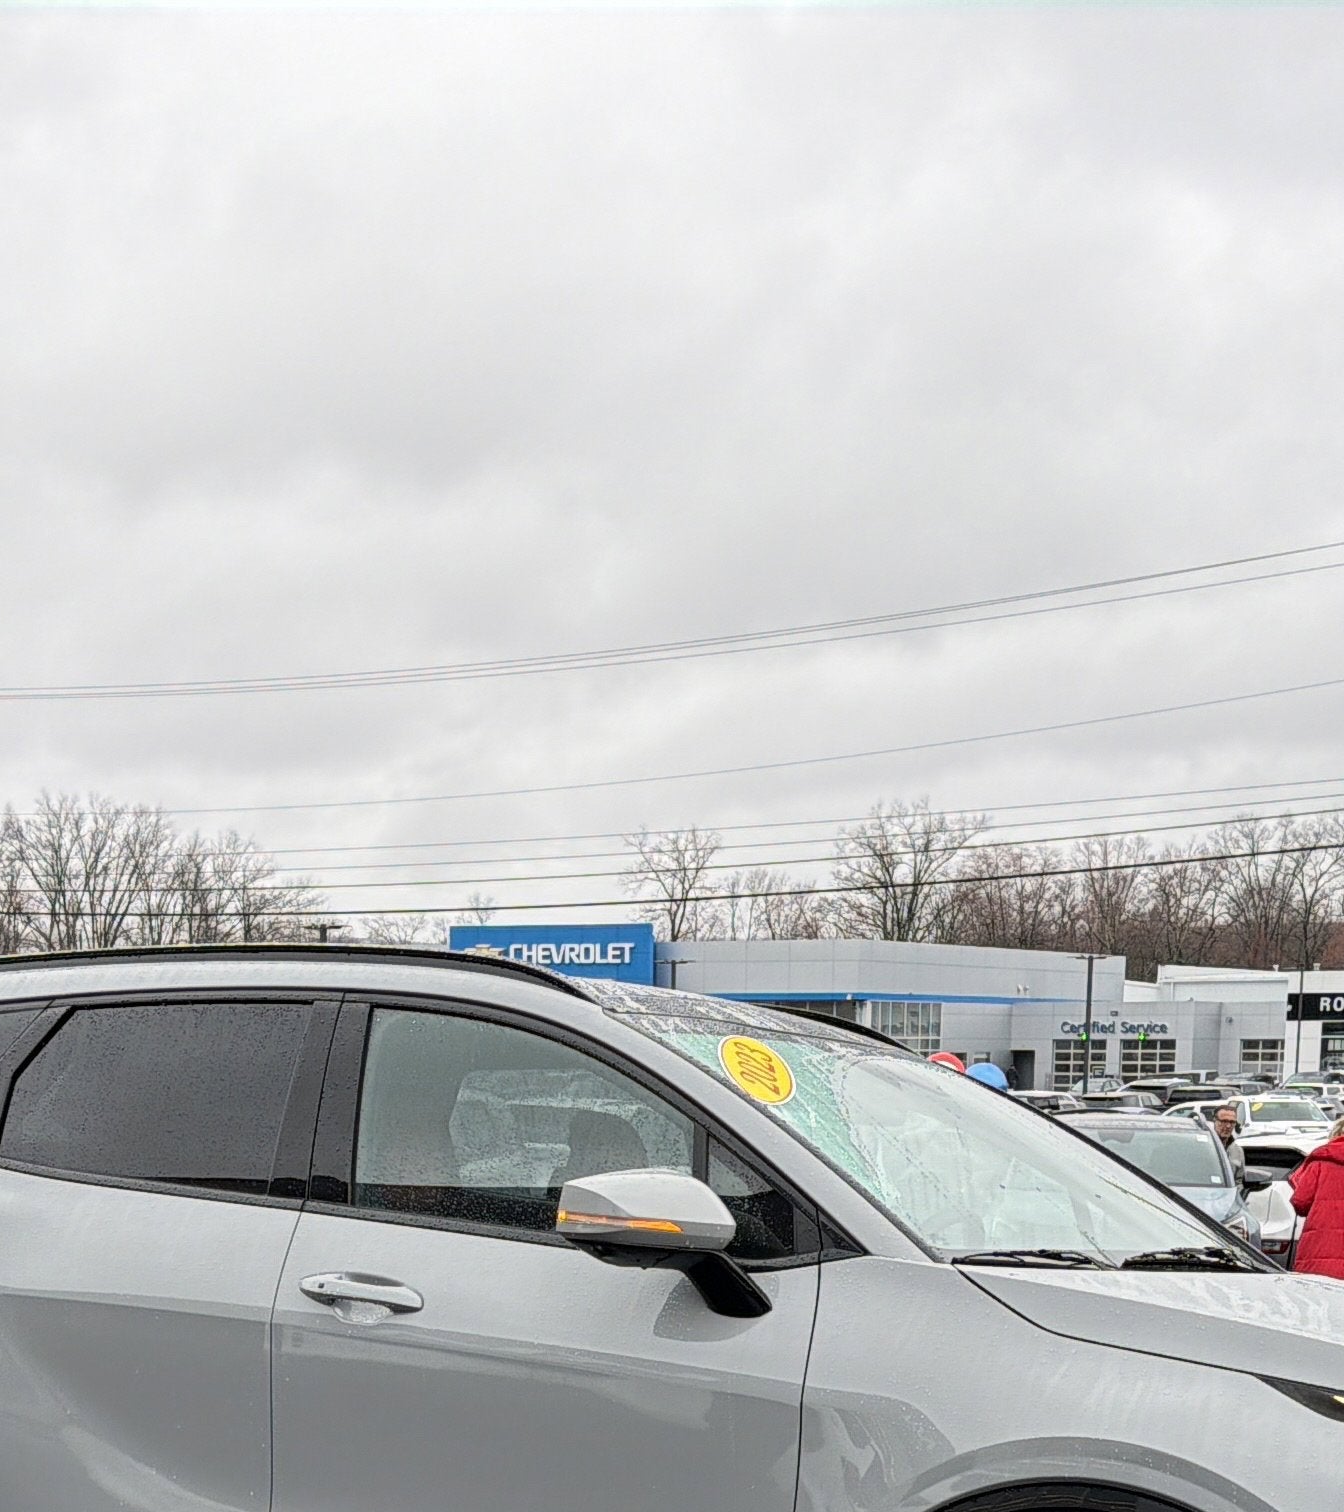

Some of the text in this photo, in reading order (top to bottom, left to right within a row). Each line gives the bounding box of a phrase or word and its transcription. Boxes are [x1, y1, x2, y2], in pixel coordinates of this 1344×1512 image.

[509, 942, 635, 965] CHEVROLET
[1061, 1020, 1168, 1035] Certfied Service
[733, 1041, 780, 1096] 2023
